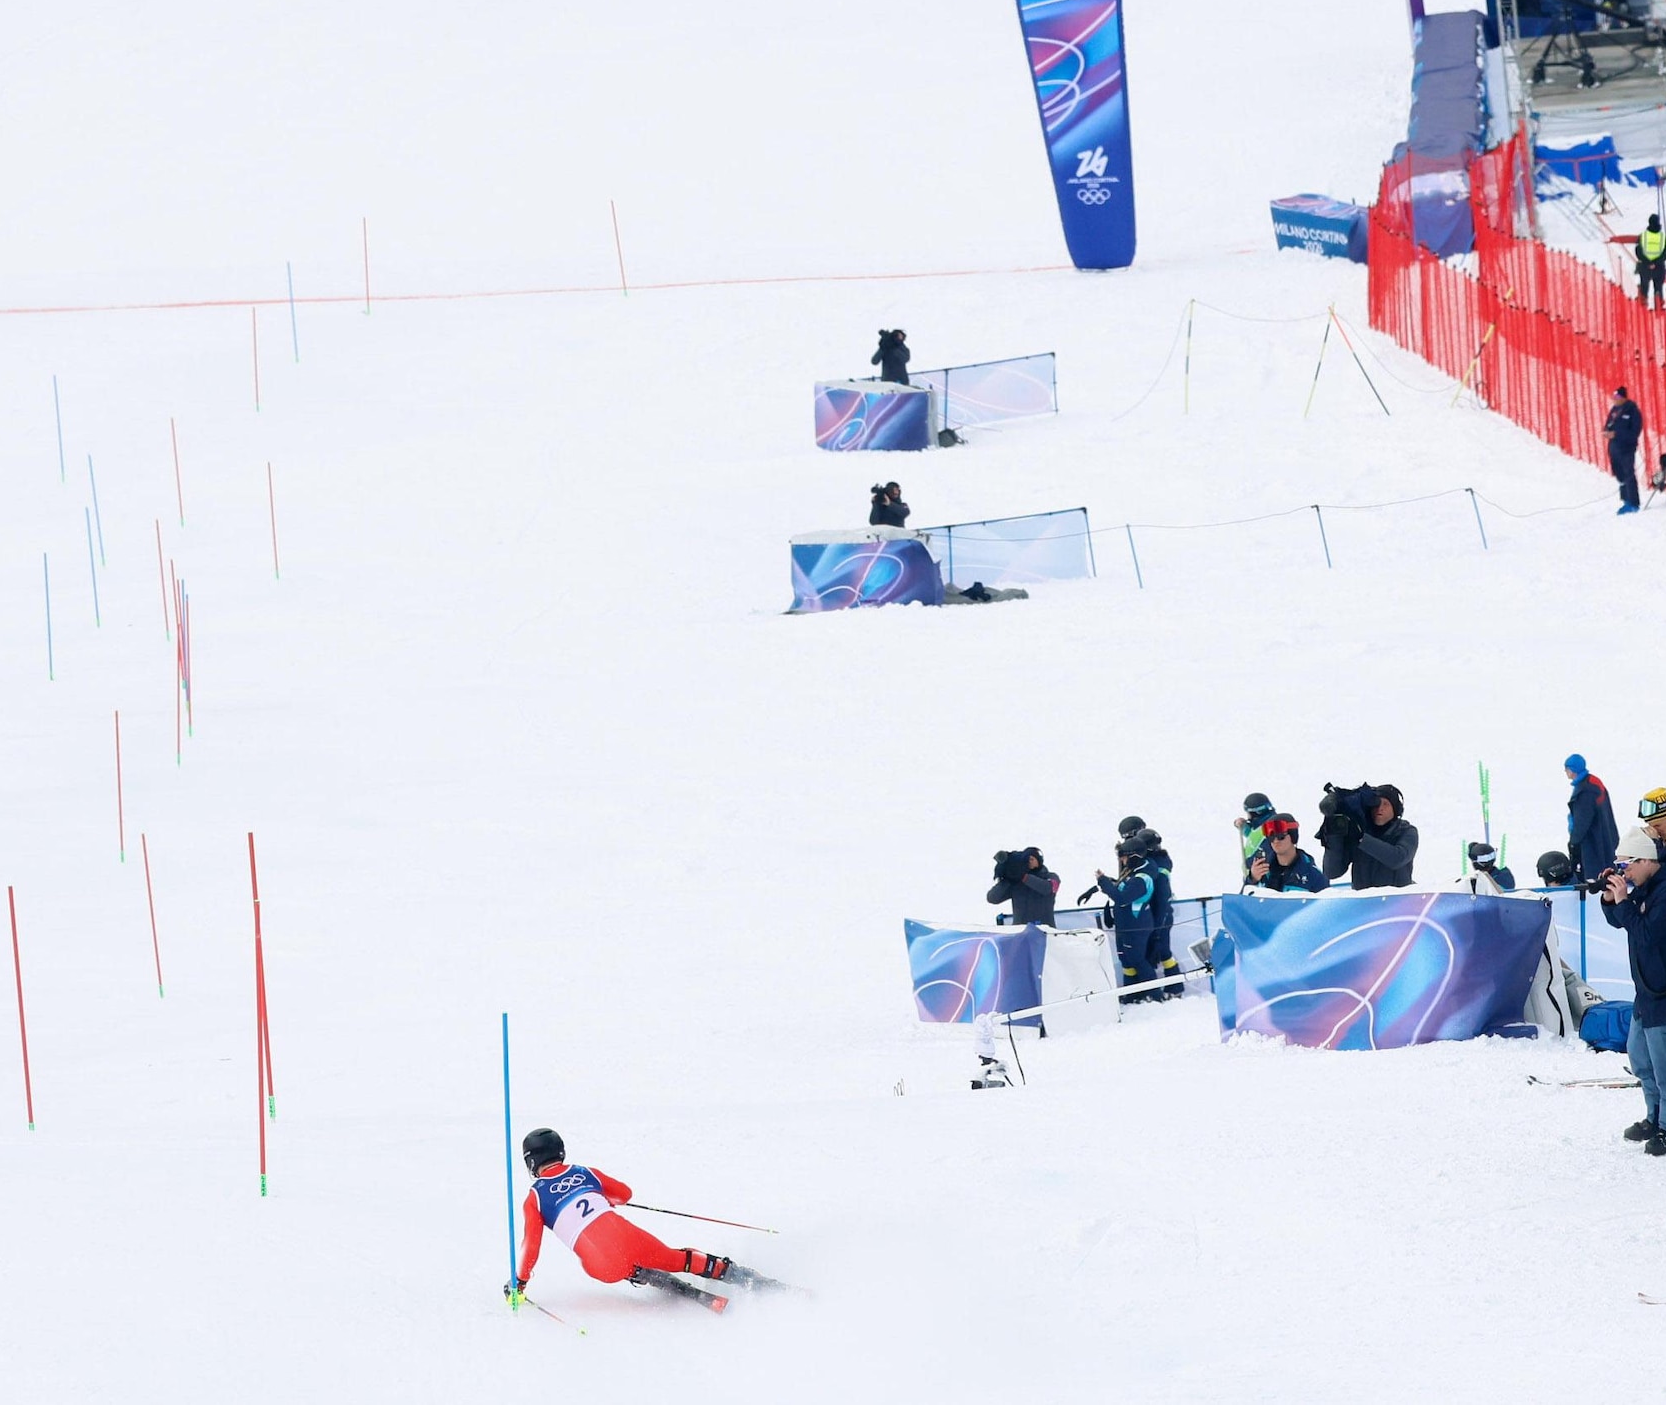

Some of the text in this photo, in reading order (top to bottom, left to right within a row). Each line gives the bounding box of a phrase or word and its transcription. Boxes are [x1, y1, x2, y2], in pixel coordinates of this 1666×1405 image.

[1076, 146, 1109, 178] 26
[1274, 222, 1309, 240] MILANO
[576, 1198, 594, 1218] 2
